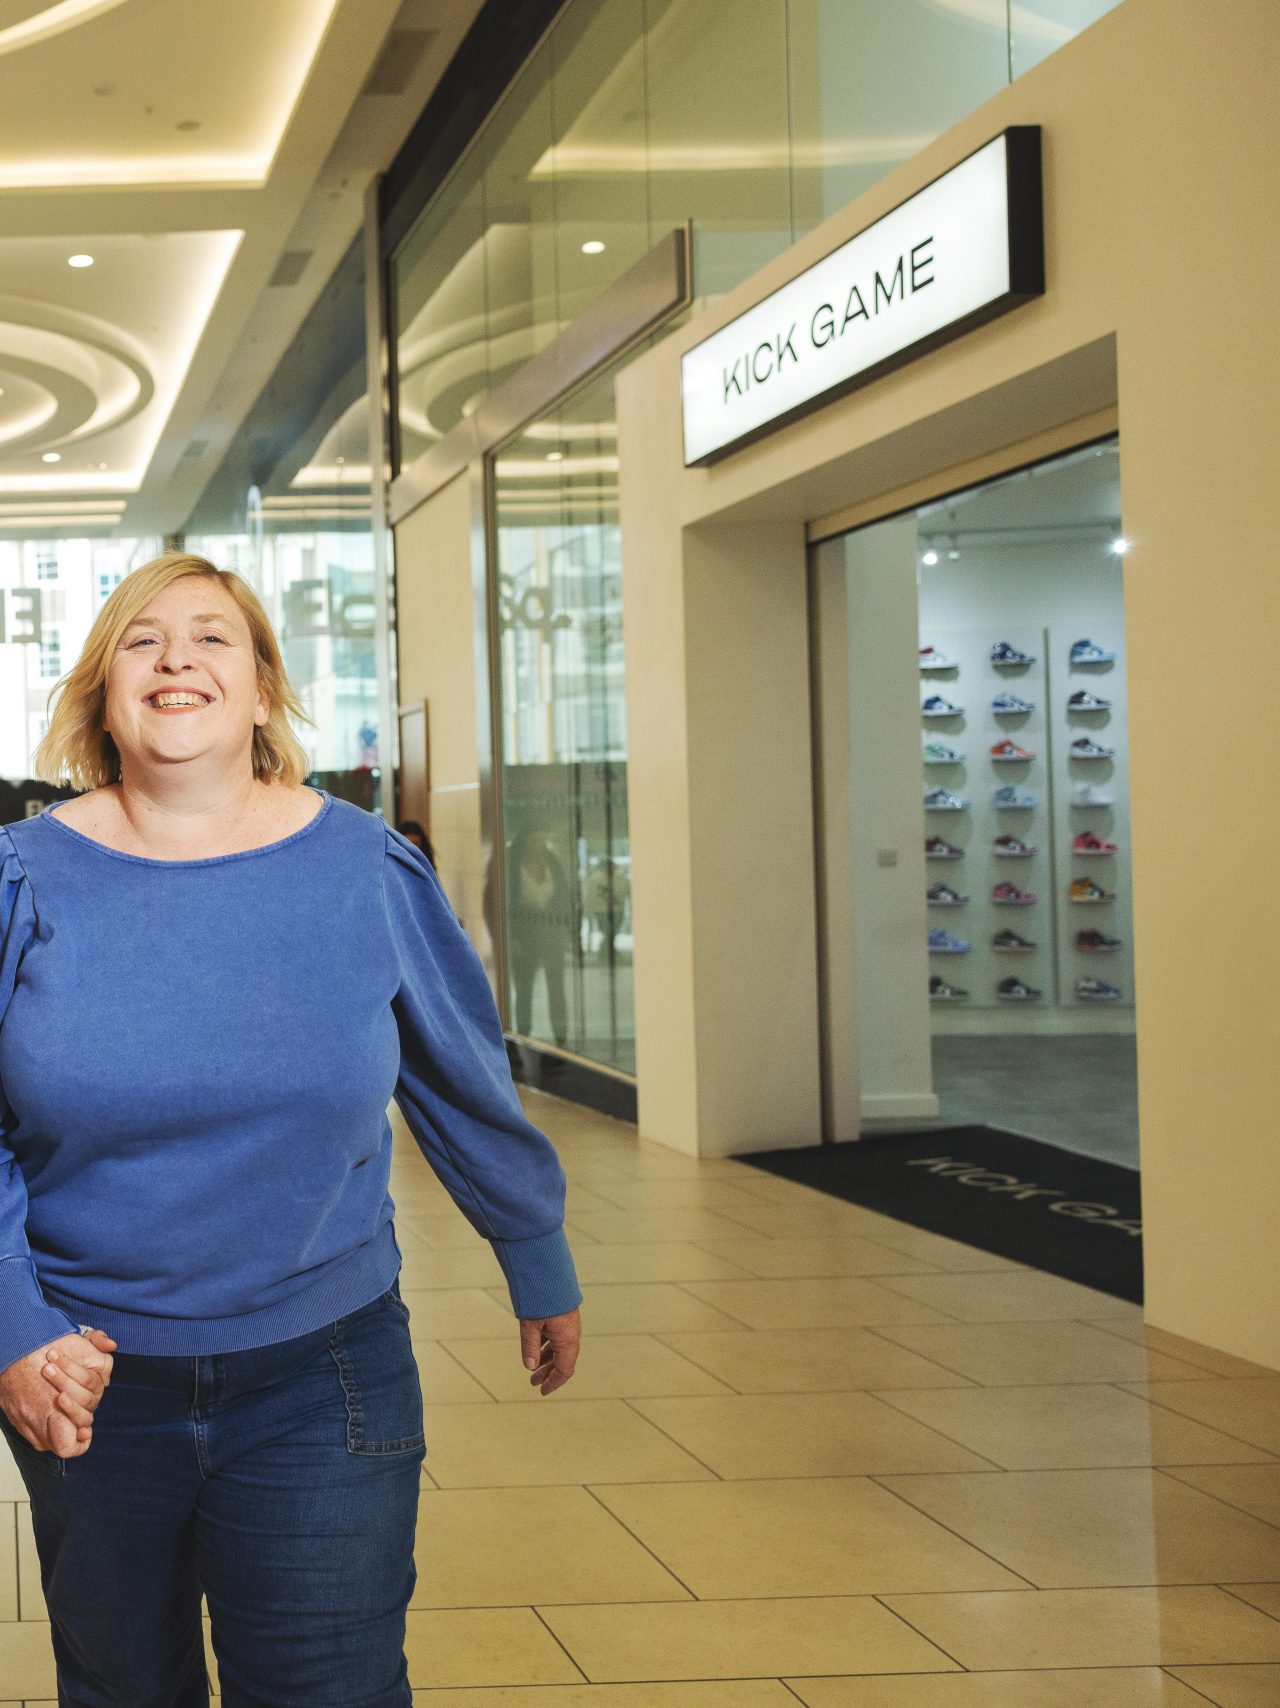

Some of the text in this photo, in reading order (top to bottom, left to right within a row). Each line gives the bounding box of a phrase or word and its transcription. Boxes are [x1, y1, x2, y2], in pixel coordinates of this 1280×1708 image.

[723, 235, 935, 403] KICK GAME
[905, 1156, 1144, 1236] KICK GA
